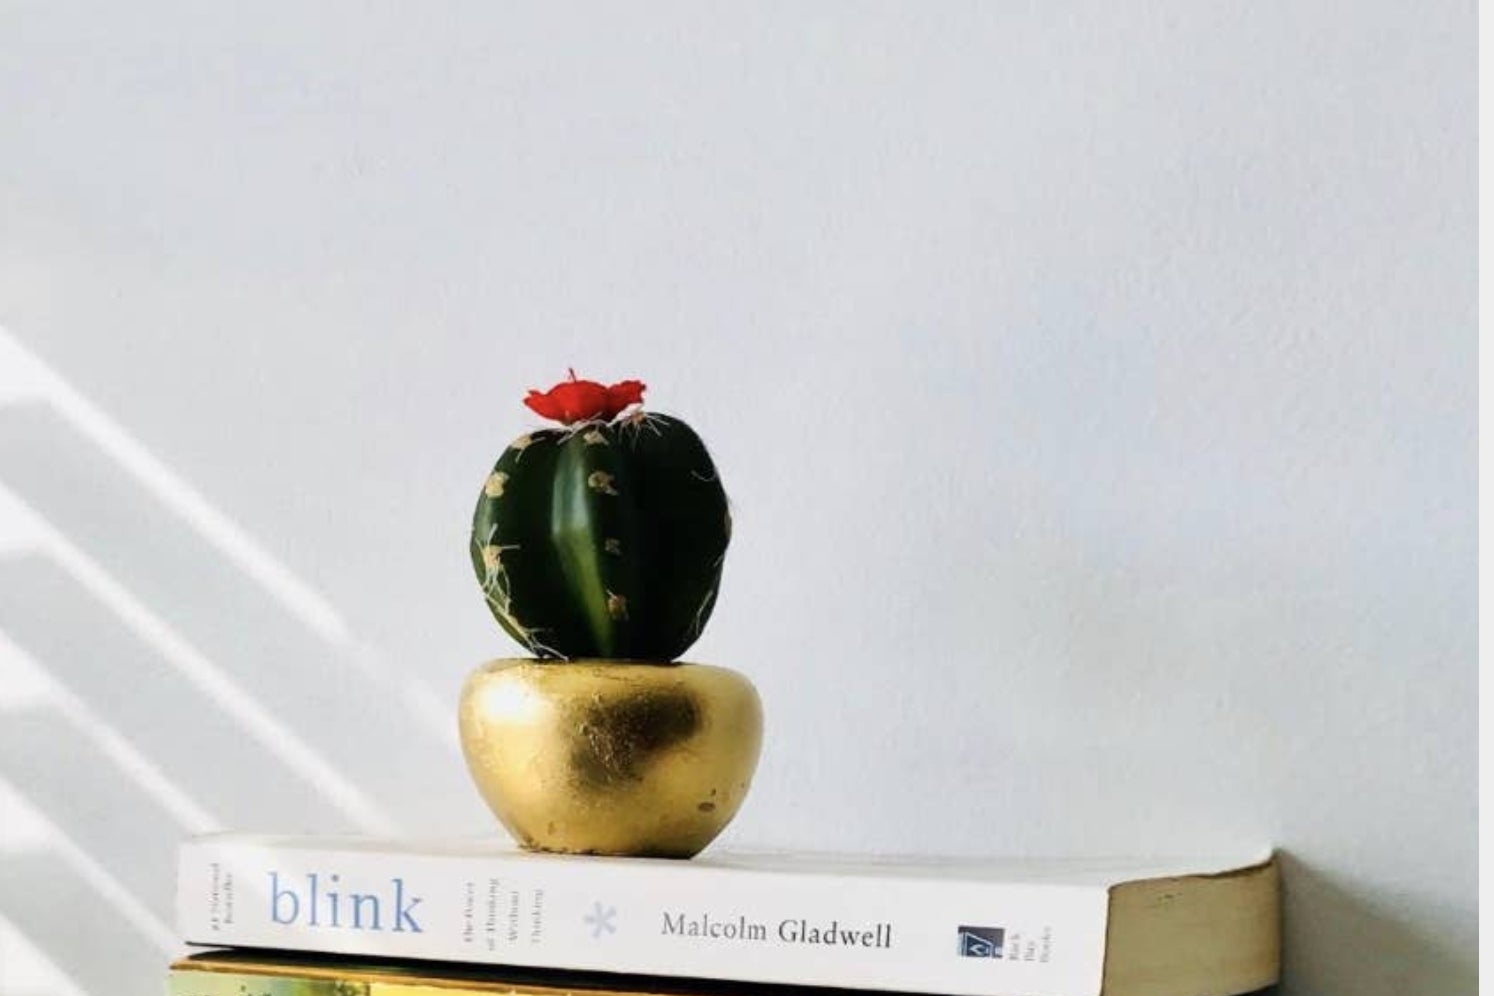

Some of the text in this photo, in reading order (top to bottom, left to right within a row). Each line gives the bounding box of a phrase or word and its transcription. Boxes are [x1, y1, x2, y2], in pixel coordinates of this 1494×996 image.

[268, 873, 424, 934] blink
[661, 911, 892, 949] Malcolm Gladwell
